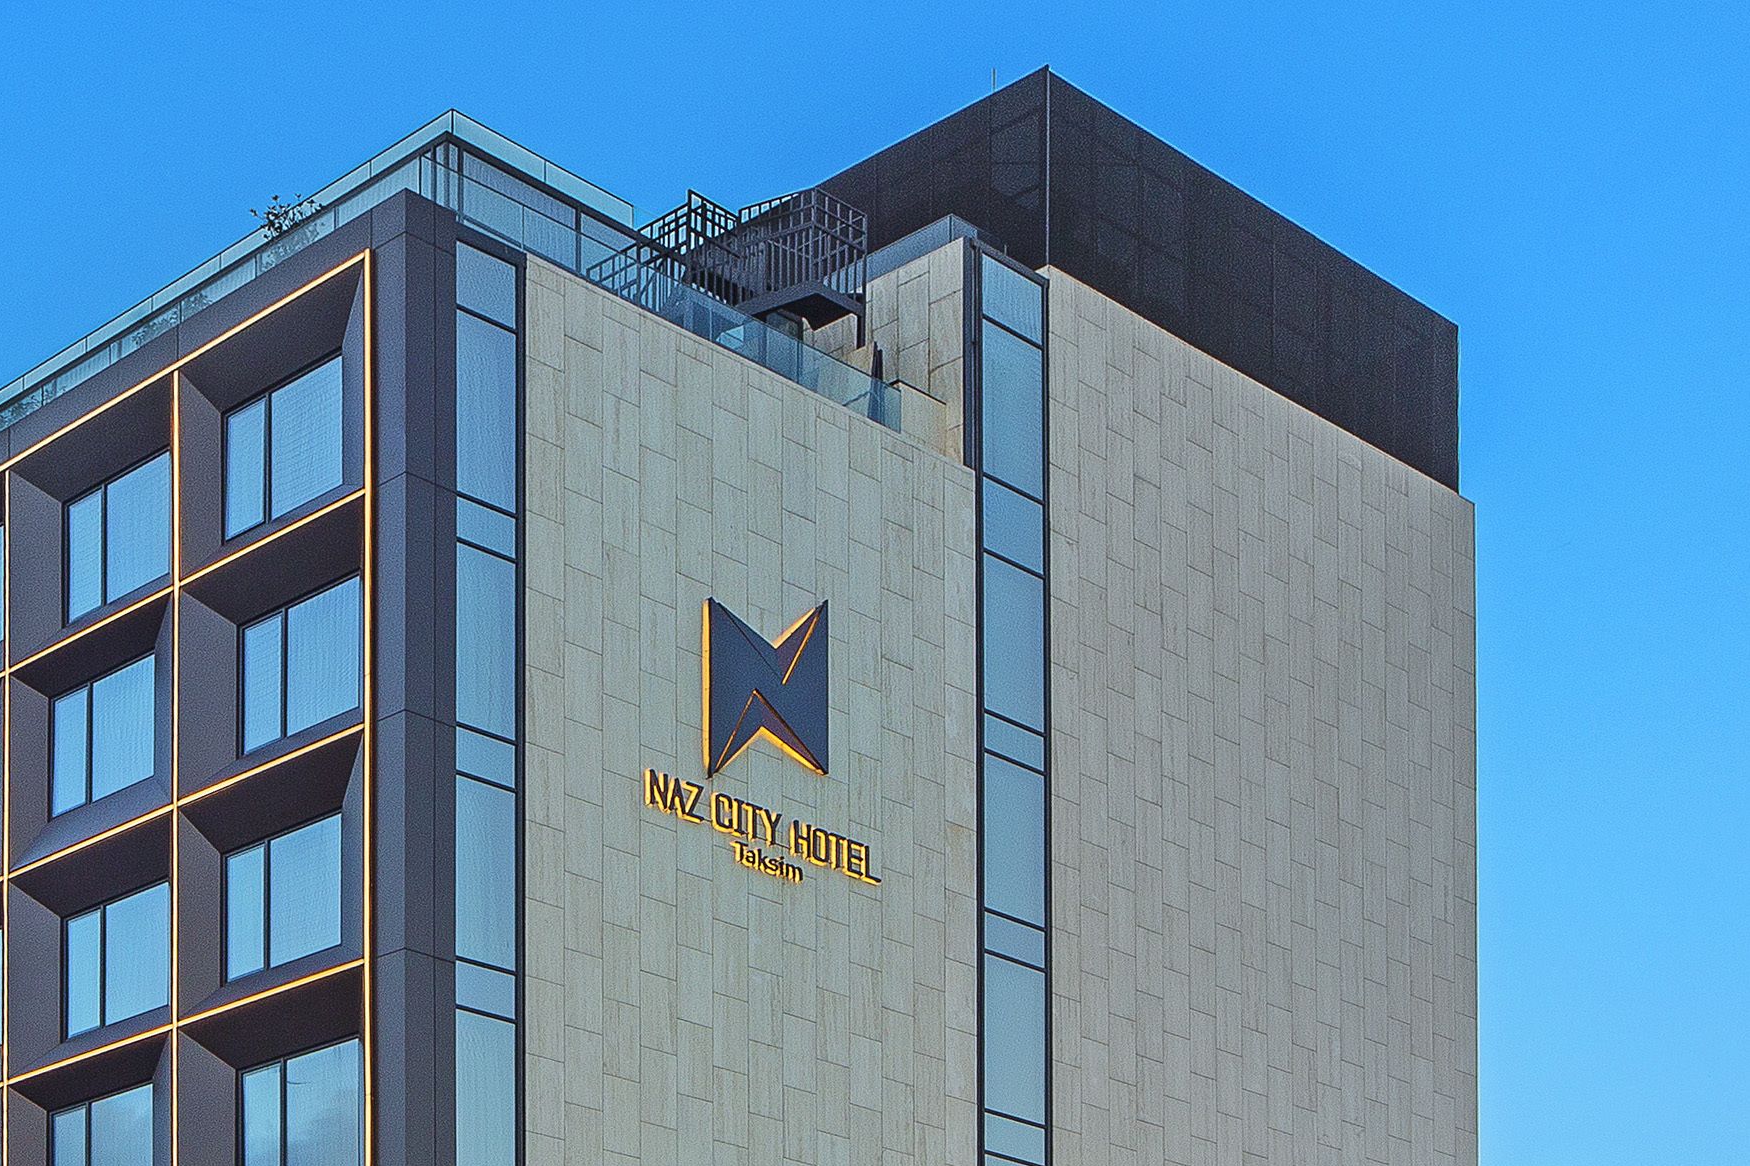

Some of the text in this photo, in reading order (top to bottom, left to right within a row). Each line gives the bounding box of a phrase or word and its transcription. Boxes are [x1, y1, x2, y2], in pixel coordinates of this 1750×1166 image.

[643, 768, 882, 886] NAZ CITY HOTEL
[730, 841, 804, 884] Taksim
